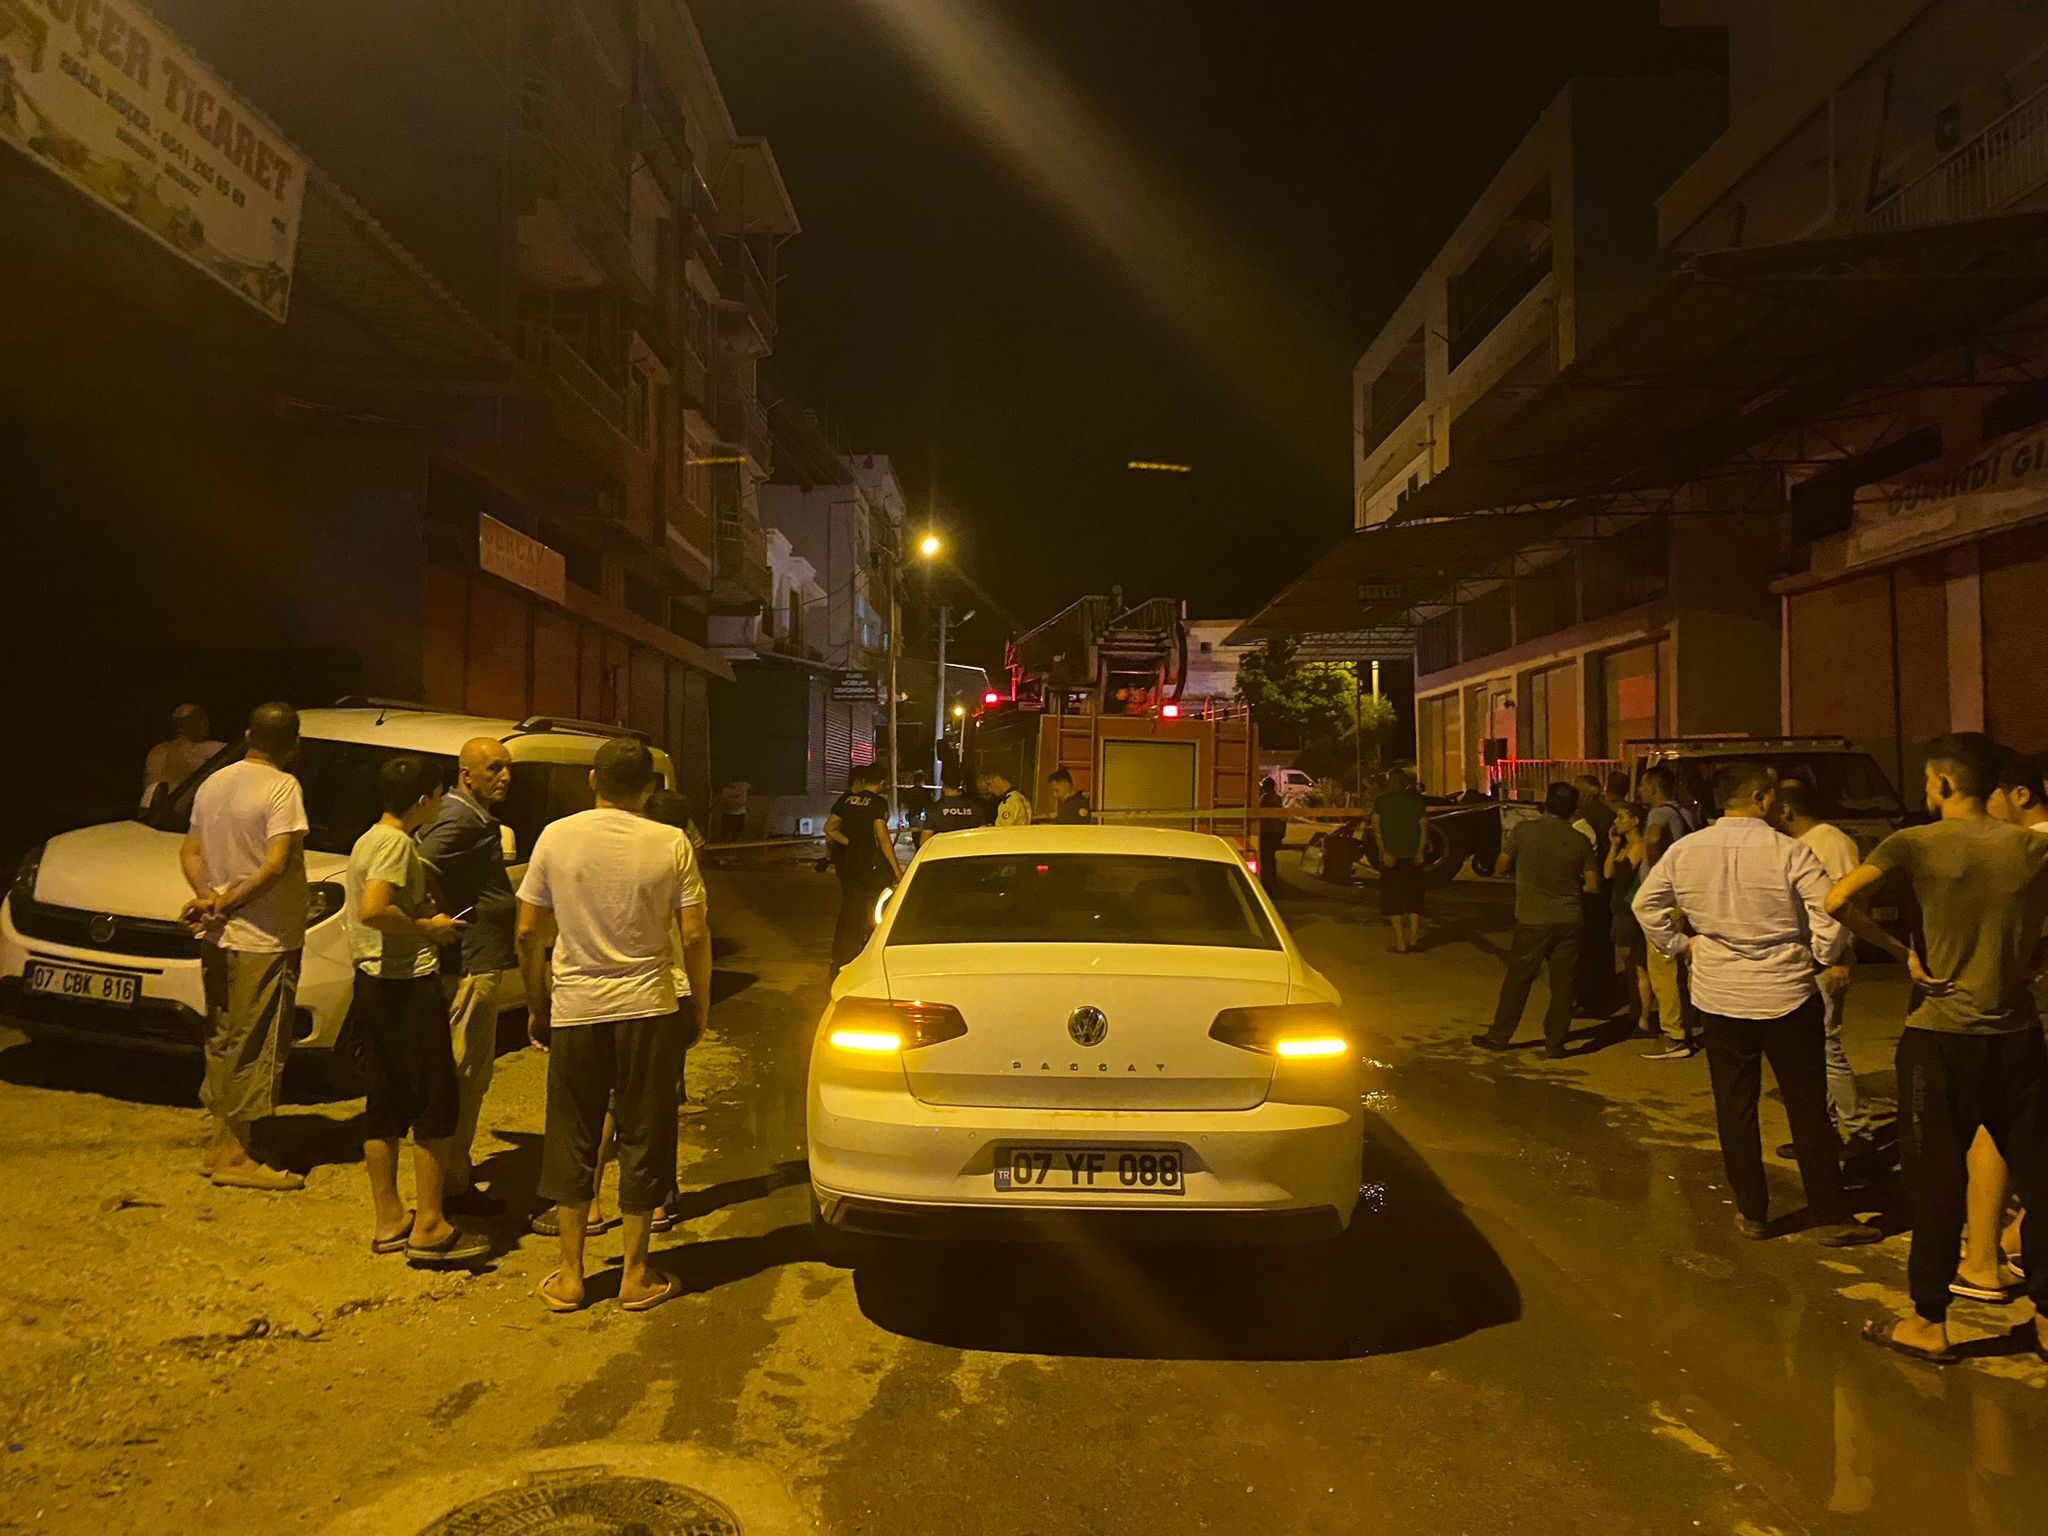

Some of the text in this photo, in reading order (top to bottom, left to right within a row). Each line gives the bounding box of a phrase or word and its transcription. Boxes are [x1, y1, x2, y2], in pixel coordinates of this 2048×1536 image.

[36, 0, 152, 91] ÇER
[942, 807, 973, 817] POLIS
[34, 968, 133, 1000] 07 CBK 816
[1012, 1060, 1166, 1073] PASSAT
[998, 1152, 1179, 1187] TR 07 YF 088
